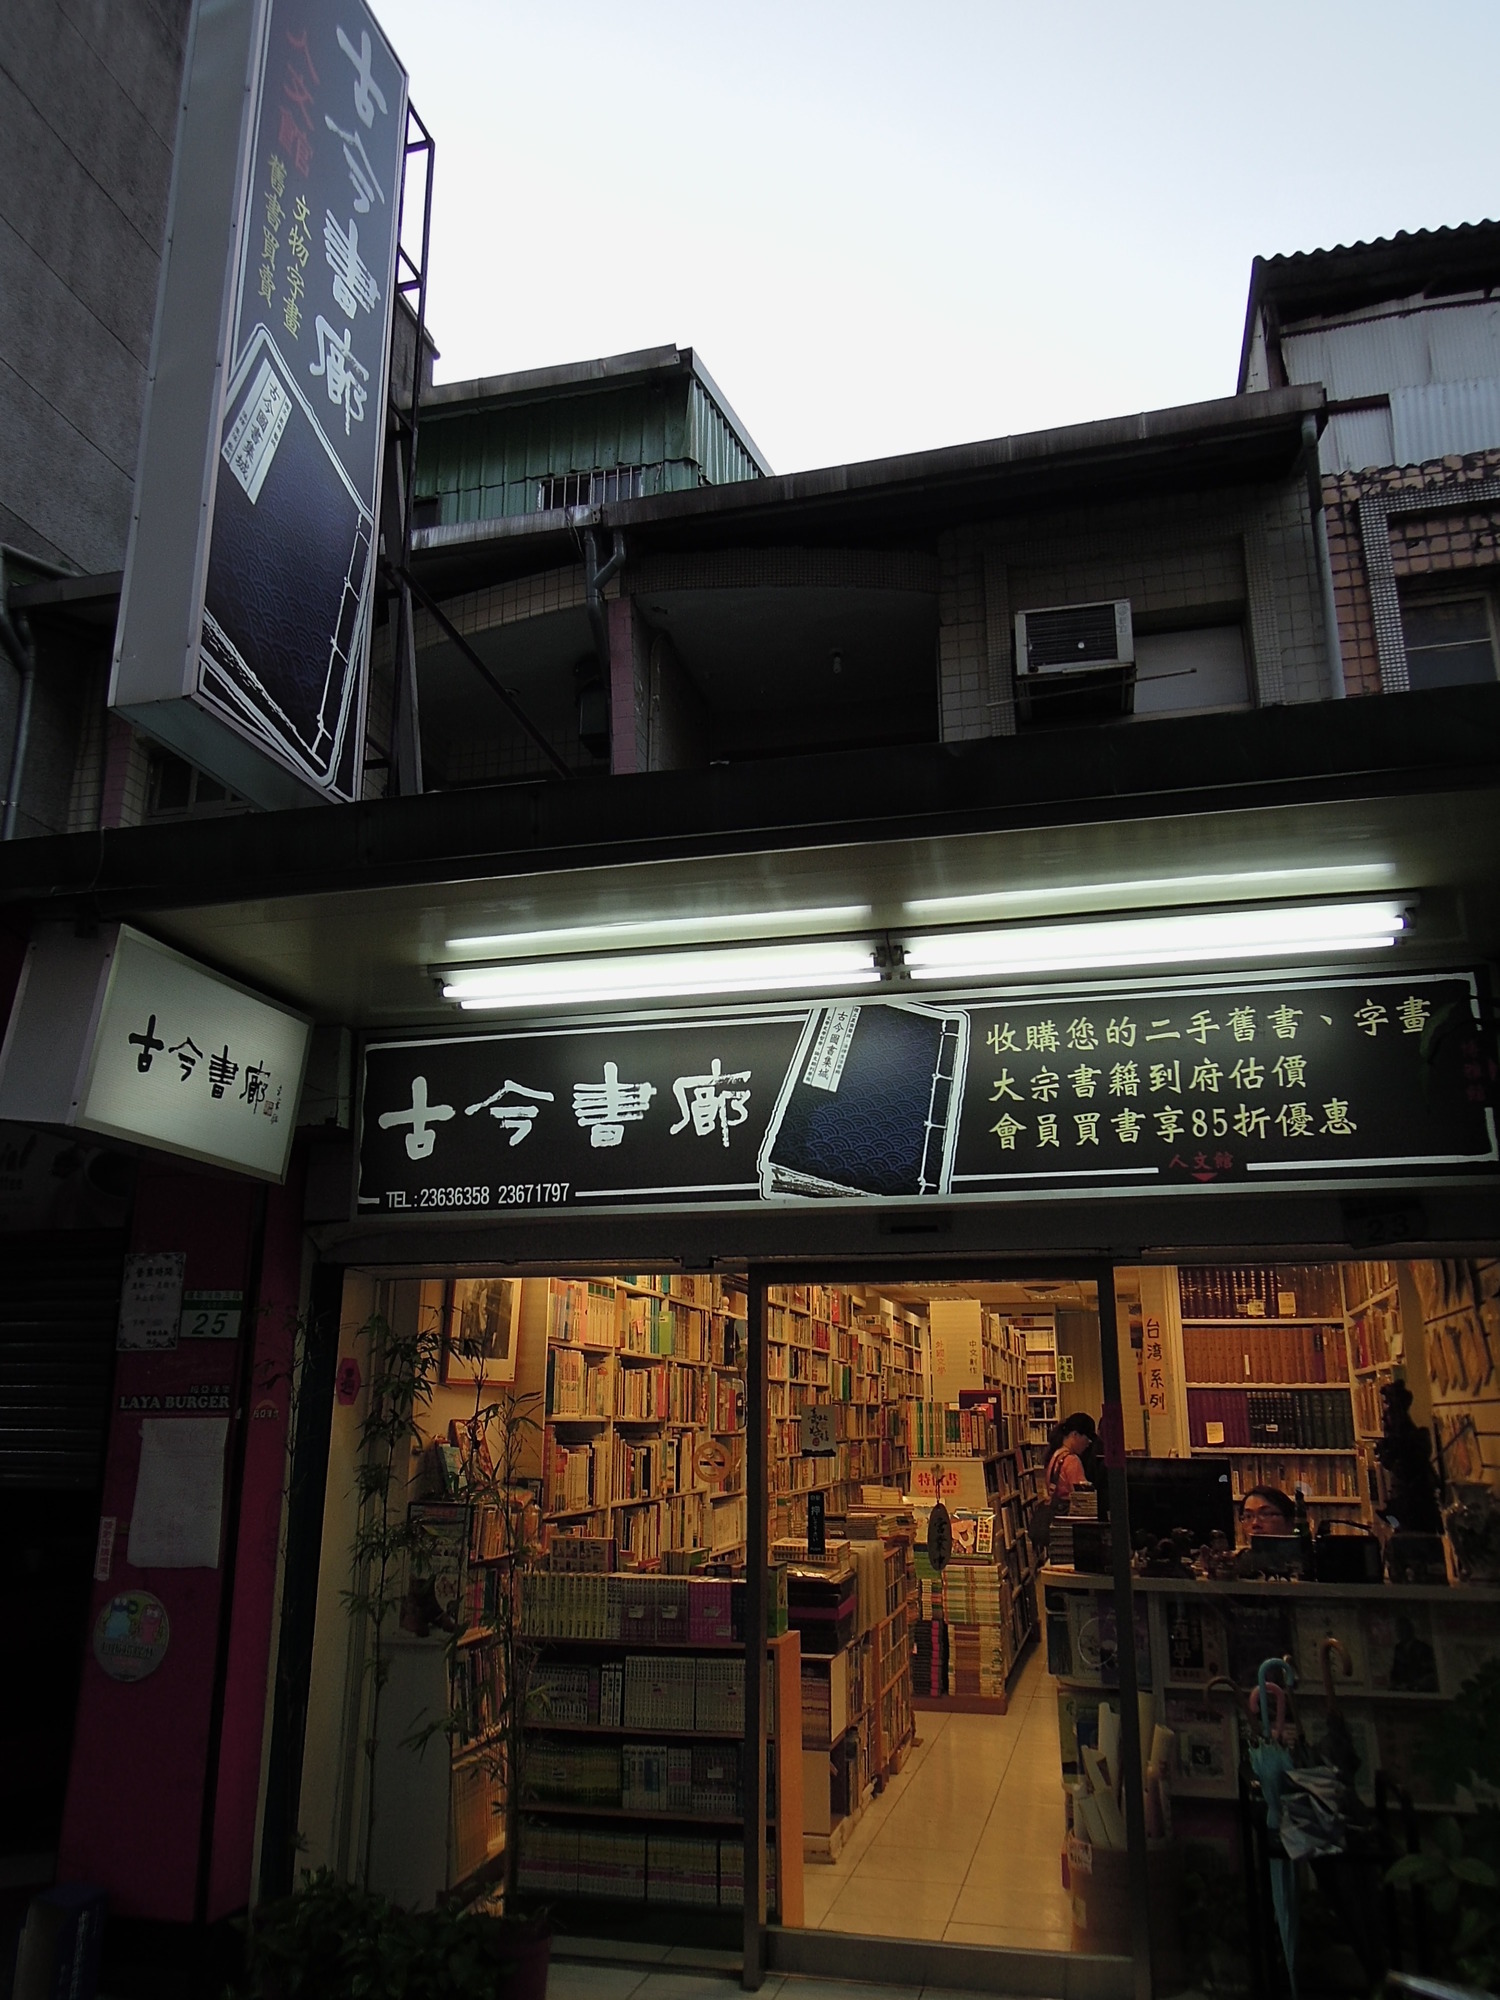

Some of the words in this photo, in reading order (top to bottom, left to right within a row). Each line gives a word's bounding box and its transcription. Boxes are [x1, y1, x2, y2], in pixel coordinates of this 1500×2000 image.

[278, 26, 320, 179] 人文館
[258, 153, 287, 309] 舊書買賣
[284, 195, 312, 341] 文物字畫
[309, 24, 388, 436] 古今書廊
[128, 1014, 271, 1114] 古今書廊
[988, 1054, 1308, 1104] 大宗書籍到府估價
[378, 1058, 751, 1160] 古今書廊
[988, 1096, 1357, 1151] 會員買書享85折優惠
[498, 1183, 570, 1204] 23671797
[1168, 1152, 1234, 1169] 人文館
[191, 1313, 228, 1335] 25
[119, 1395, 161, 1409] LAYA
[164, 1395, 230, 1409] BURGER
